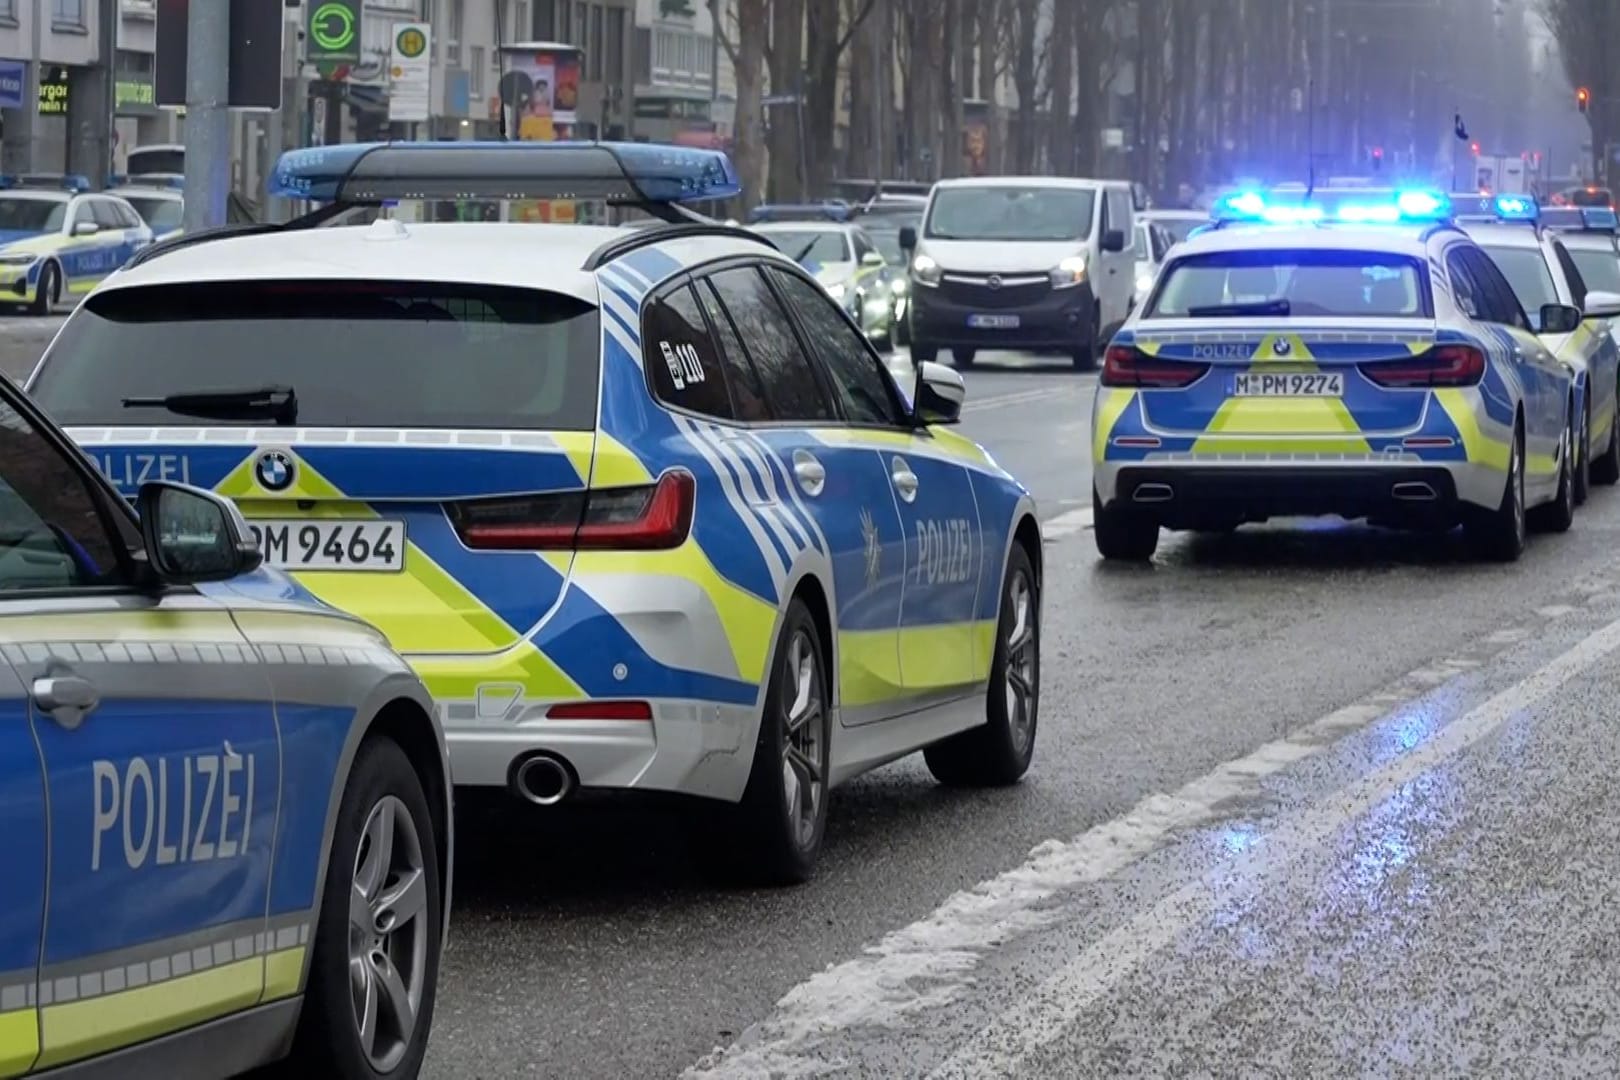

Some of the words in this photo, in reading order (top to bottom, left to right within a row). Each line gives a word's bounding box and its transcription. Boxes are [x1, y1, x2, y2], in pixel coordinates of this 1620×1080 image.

[1192, 344, 1250, 358] POLIZEI
[1236, 376, 1249, 394] M
[1262, 376, 1288, 394] PM
[1292, 376, 1340, 394] 9274
[299, 525, 394, 563] 9464
[916, 518, 972, 584] POLIZEI
[91, 753, 255, 871] POLIZEI
